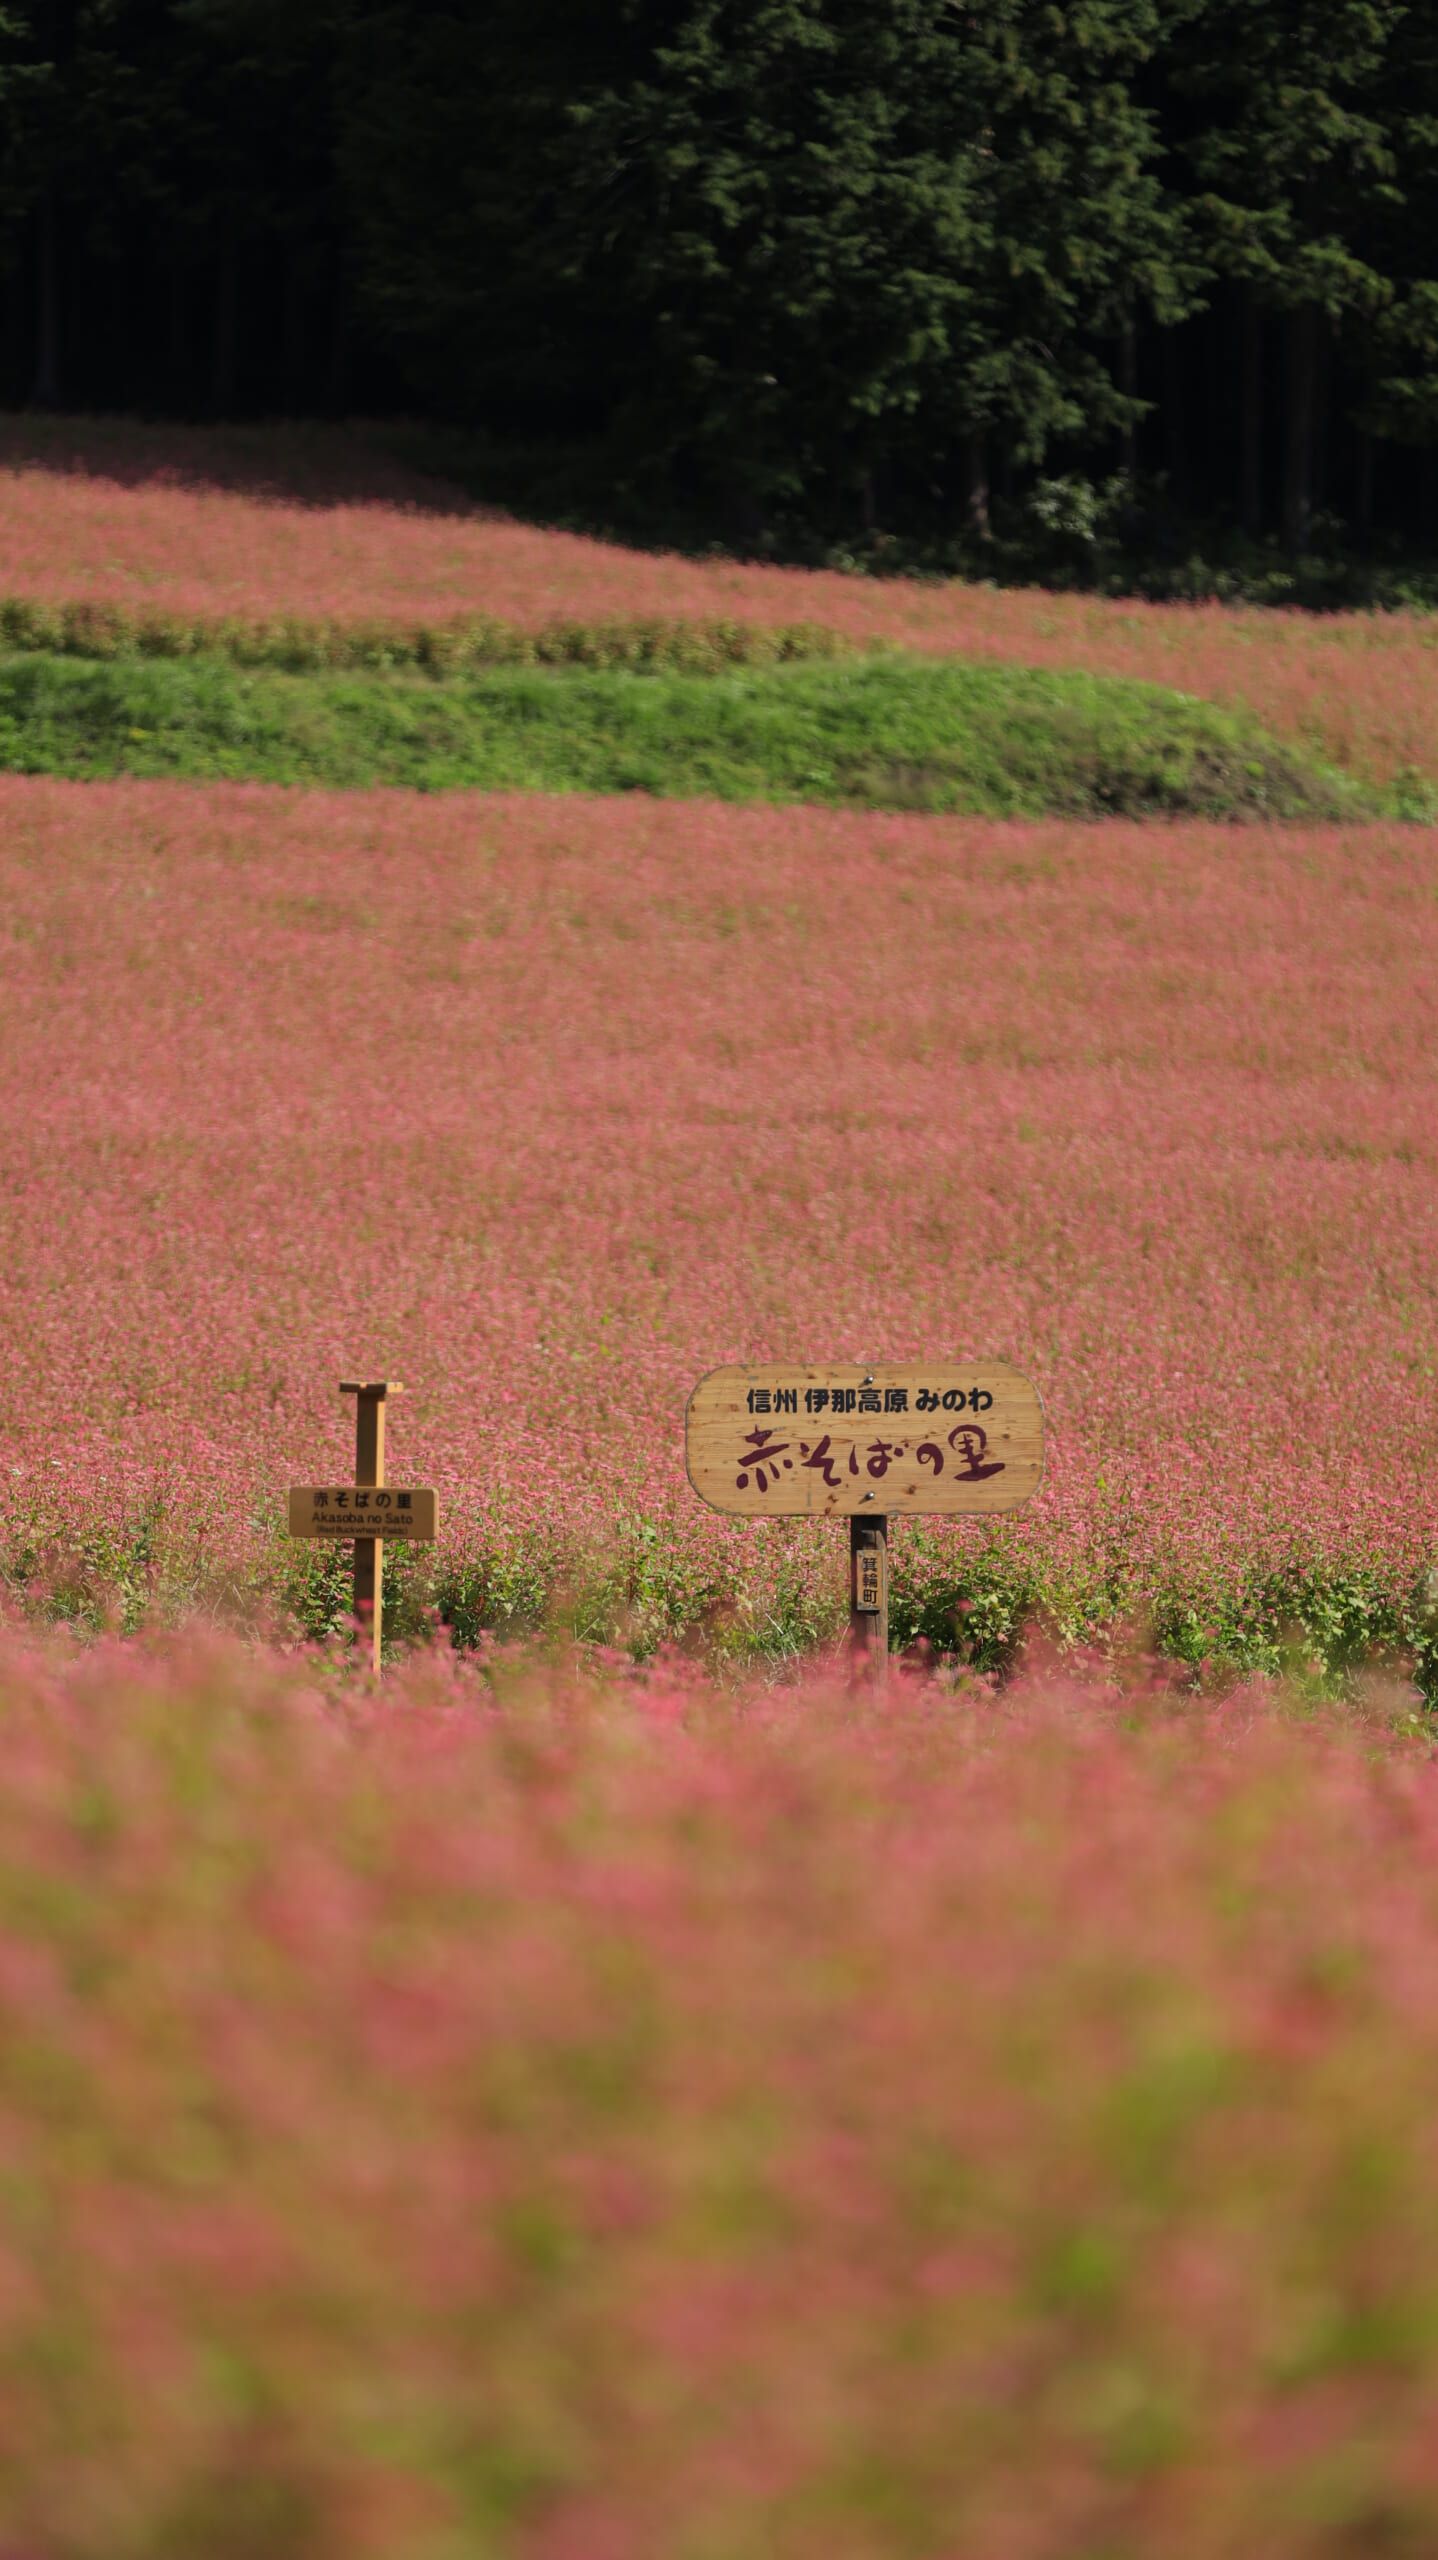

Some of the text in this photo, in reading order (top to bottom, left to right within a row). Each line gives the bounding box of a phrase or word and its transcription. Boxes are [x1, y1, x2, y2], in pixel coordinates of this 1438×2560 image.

[746, 1388, 993, 1413] 信州 伊那高原 みのわ
[736, 1424, 1006, 1493] 赤そばの里
[313, 1492, 412, 1509] 赤そばの里
[312, 1512, 413, 1524] Akasoba no Sato
